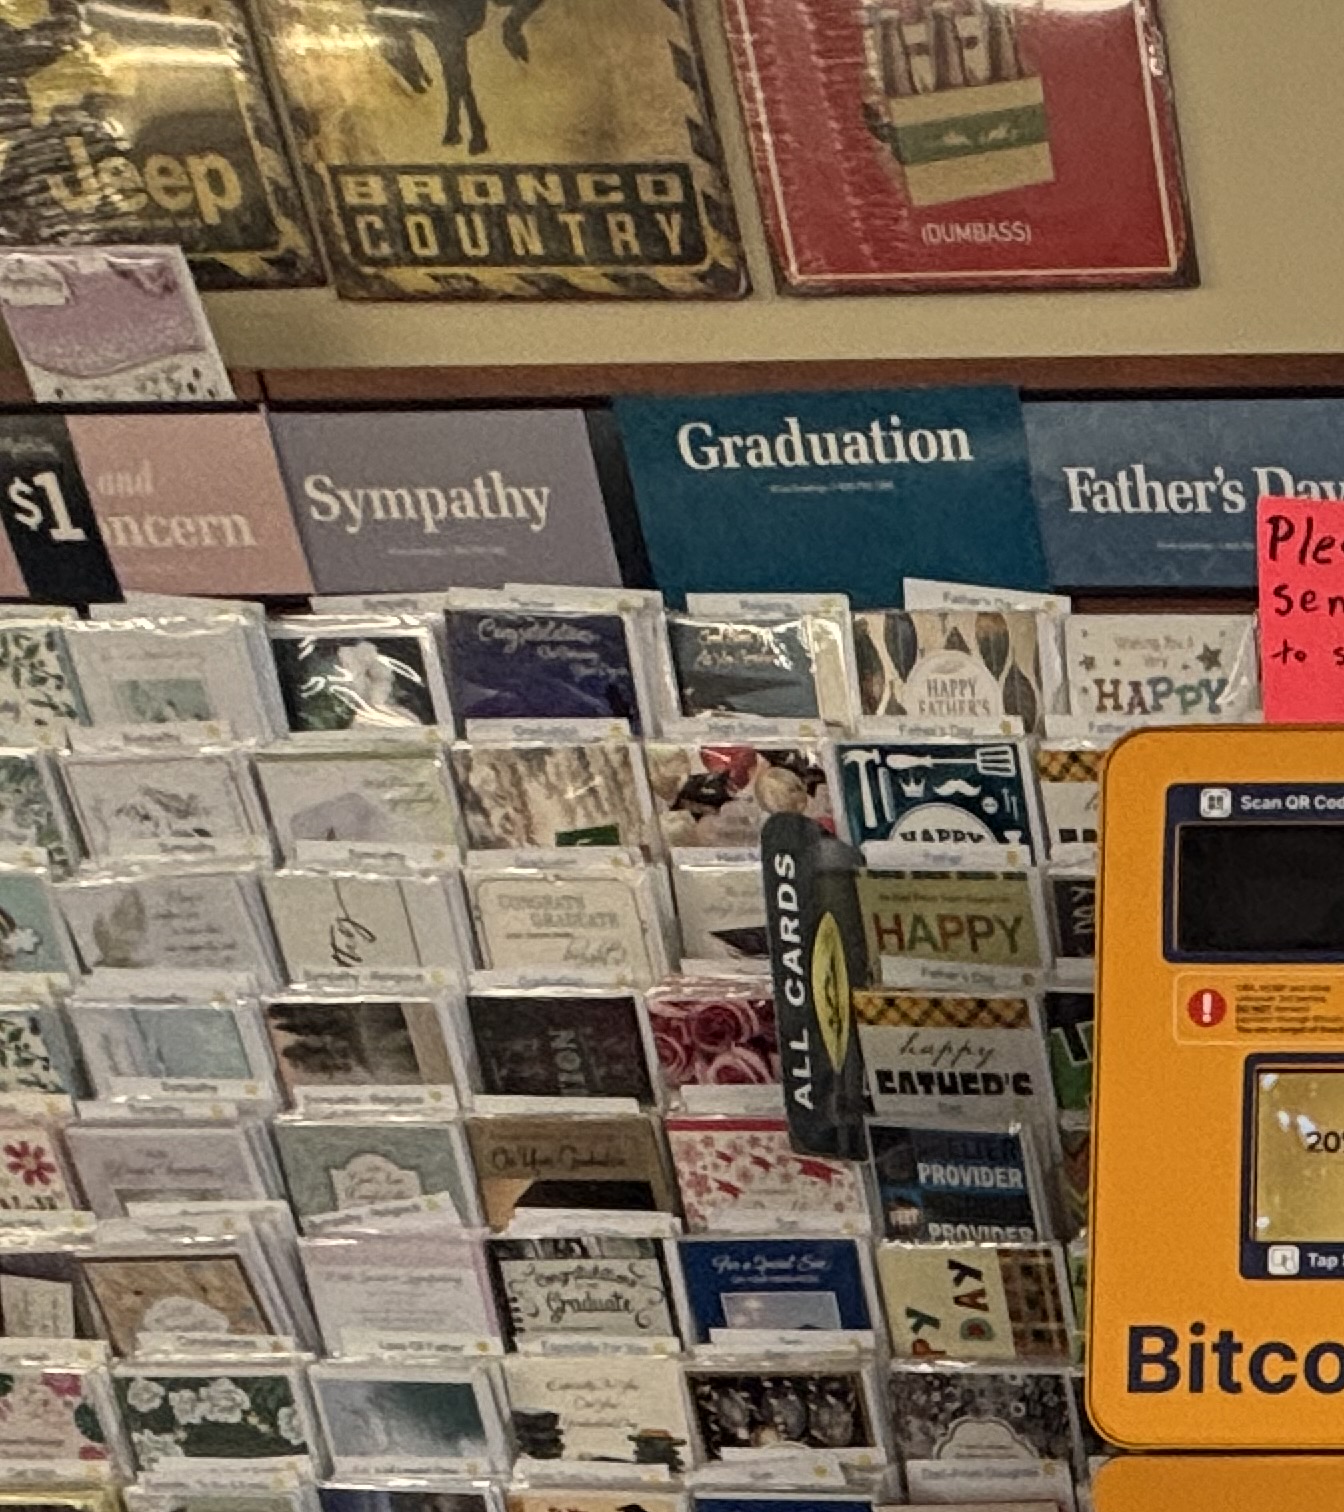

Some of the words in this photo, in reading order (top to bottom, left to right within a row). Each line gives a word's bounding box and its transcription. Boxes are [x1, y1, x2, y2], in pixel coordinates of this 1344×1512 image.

[47, 137, 241, 224] Jeep
[339, 173, 689, 205] BRONCO
[359, 211, 687, 257] COUNTRY
[921, 221, 1032, 245] (DUMBASS)
[678, 415, 974, 471] Graduation
[8, 470, 88, 541] $1
[304, 471, 551, 535] Sympathy
[1063, 465, 1246, 516] Father's
[1271, 645, 1308, 666] to
[926, 678, 977, 698] HAPPY
[1093, 675, 1229, 716] HAPPY
[918, 700, 991, 717] FATHER'S
[1240, 794, 1281, 811] Scan
[1284, 794, 1312, 812] QR
[774, 852, 807, 1008] CARDS
[874, 913, 1024, 957] HAPPY
[898, 1031, 996, 1068] happy
[789, 1028, 815, 1110] ALL
[917, 1162, 1025, 1189] PROVIDER
[928, 1222, 1035, 1241] PROVIDER
[1307, 1251, 1339, 1272] Tap
[547, 1290, 634, 1324] Graduate
